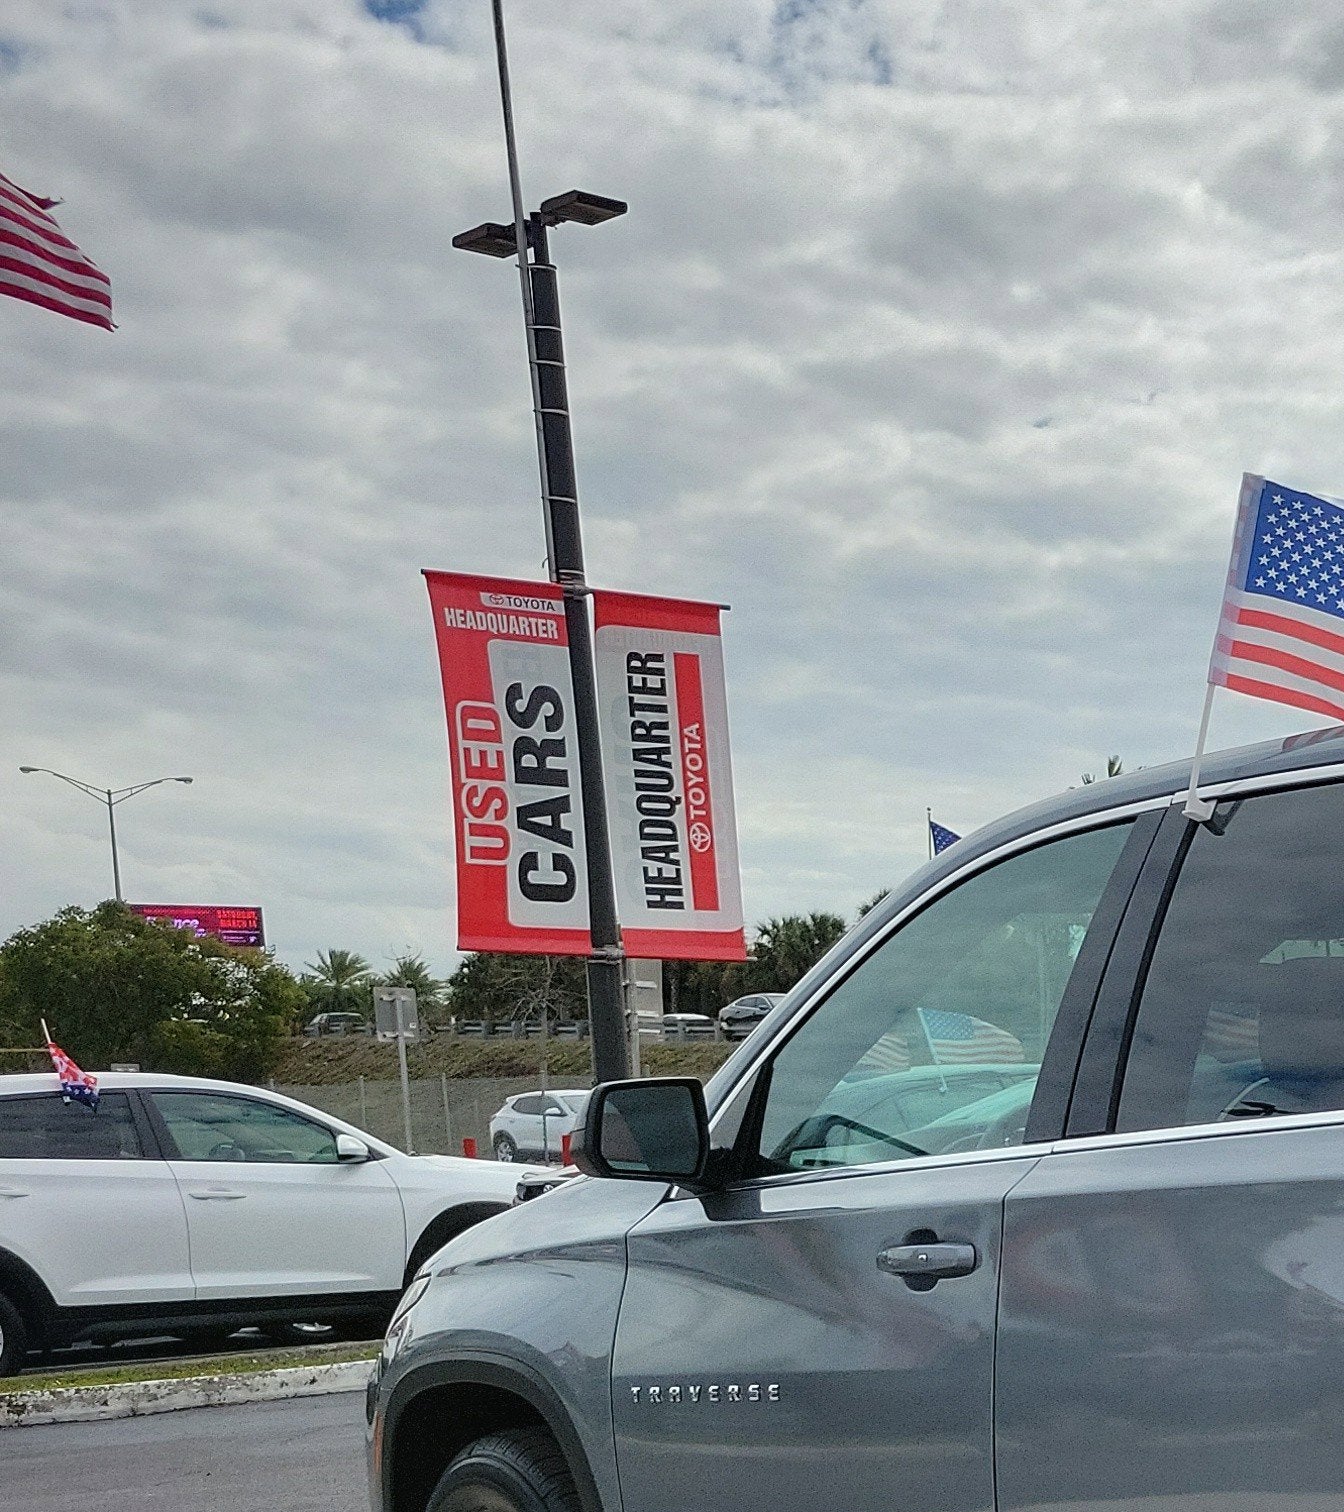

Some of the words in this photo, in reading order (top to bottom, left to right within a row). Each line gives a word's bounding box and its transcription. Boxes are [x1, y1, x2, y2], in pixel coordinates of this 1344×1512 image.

[443, 607, 558, 639] HEADQUARTER
[506, 596, 556, 612] TOYOTA
[456, 701, 510, 866] USED
[504, 681, 577, 903] CARS
[626, 651, 685, 910] HEADQUARTER
[683, 721, 707, 820] TOYOTA
[630, 1384, 781, 1404] TRAVERSE
